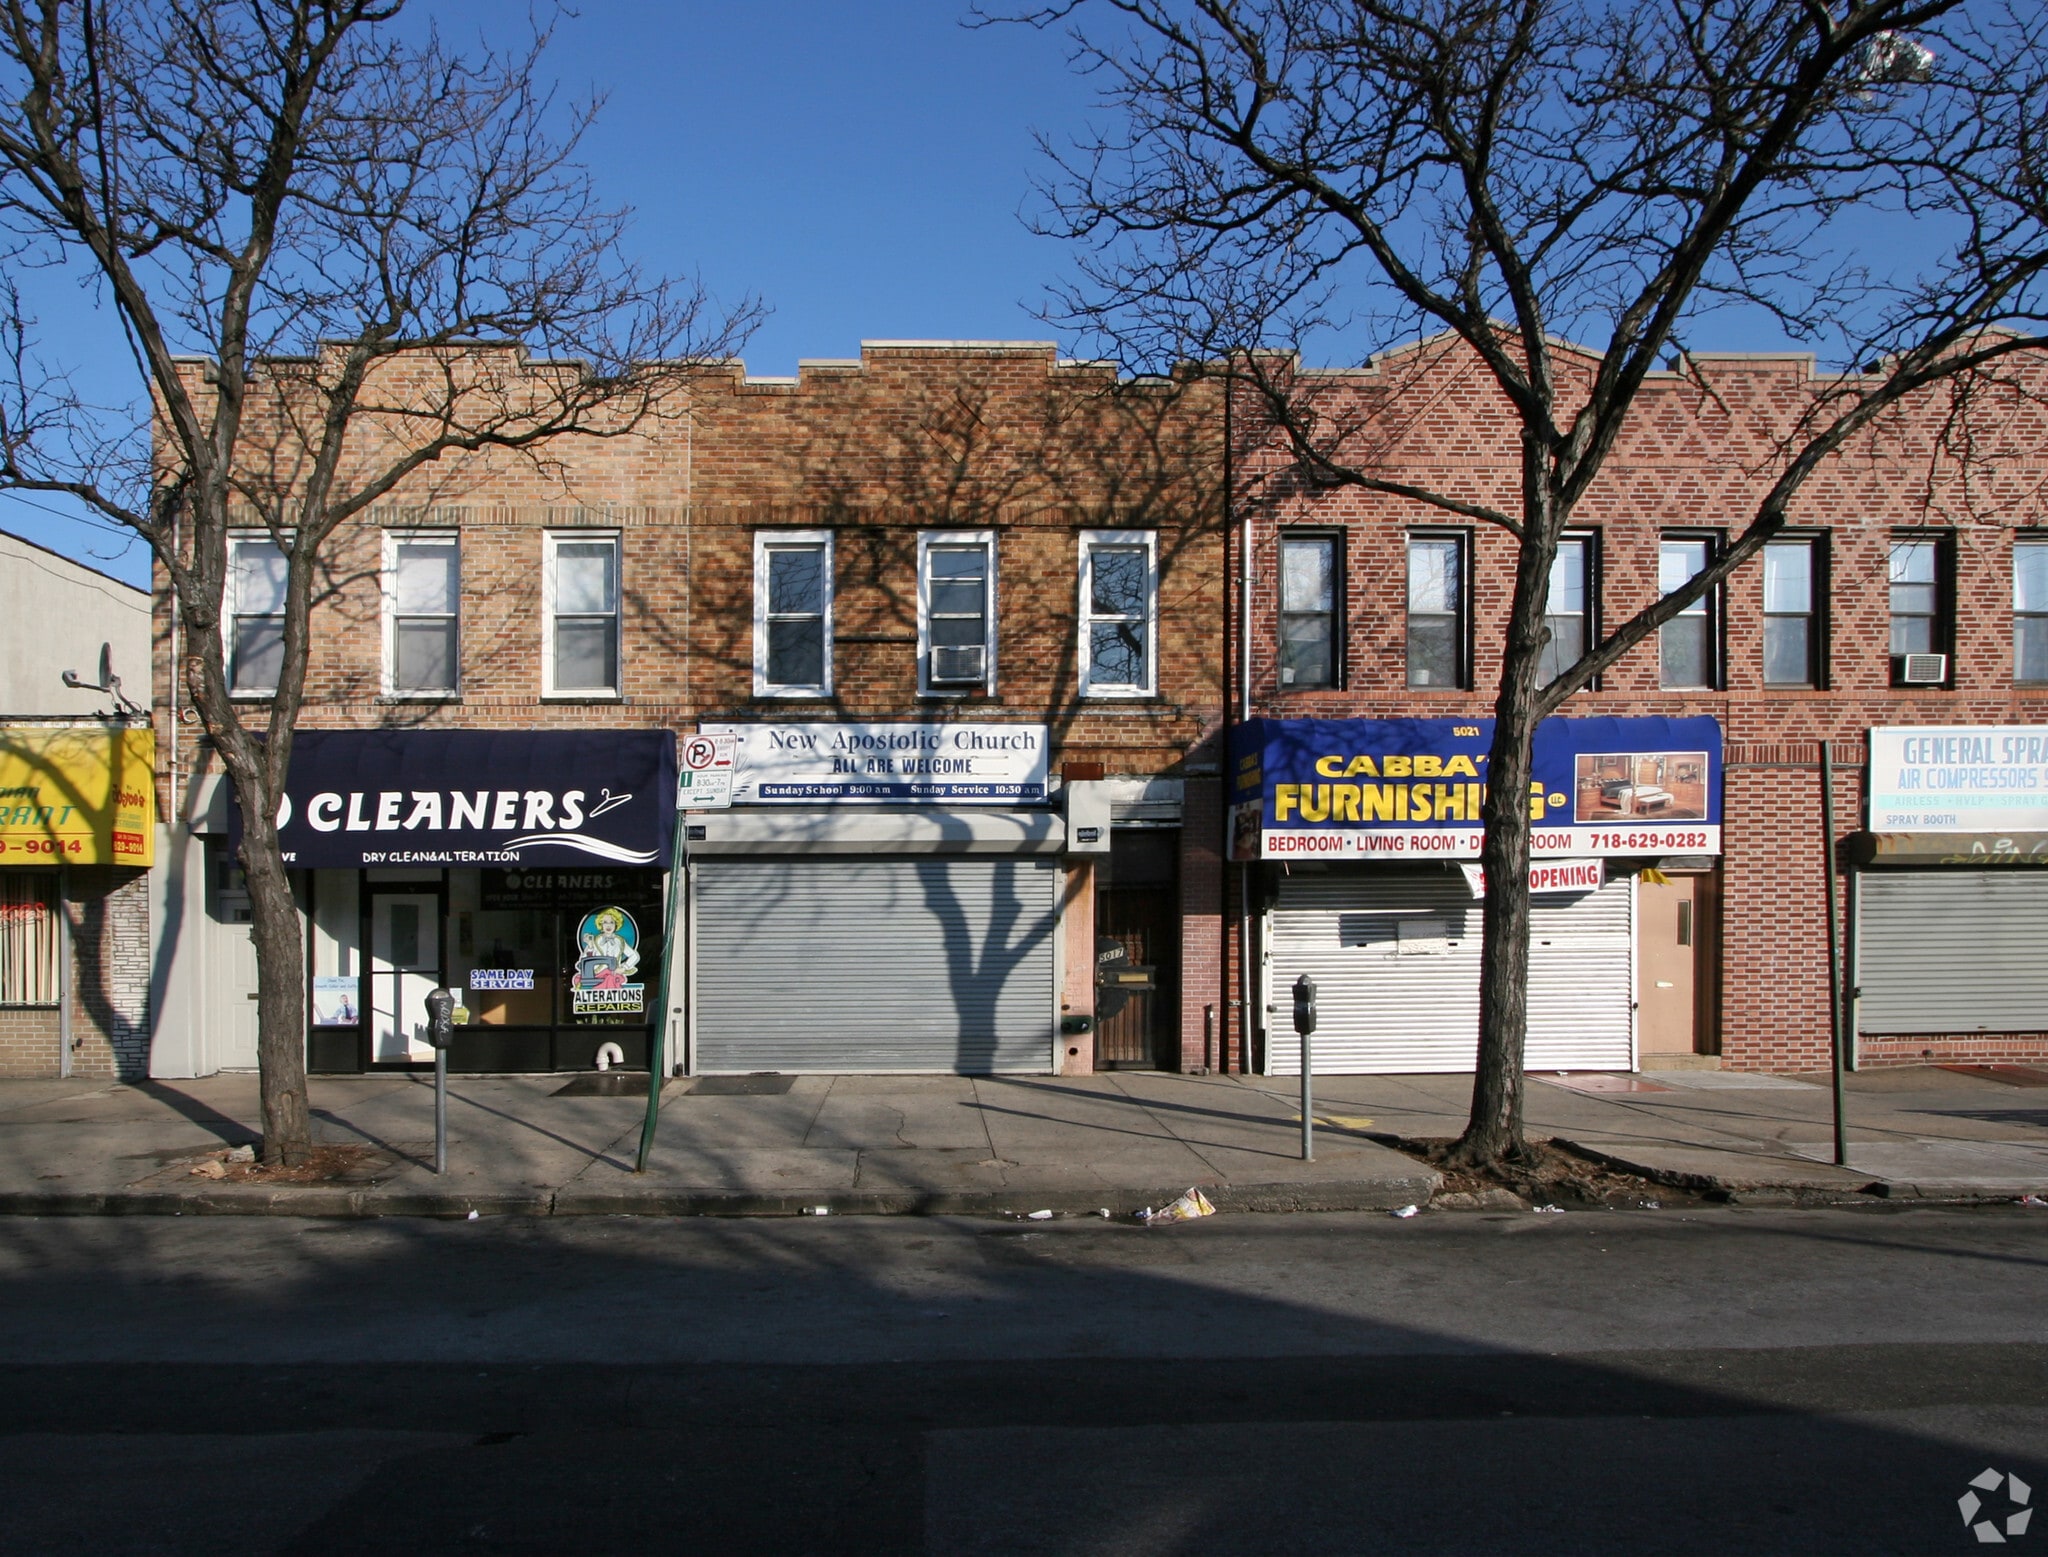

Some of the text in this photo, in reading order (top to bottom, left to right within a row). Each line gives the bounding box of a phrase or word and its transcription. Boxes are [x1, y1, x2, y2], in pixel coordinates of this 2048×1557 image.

[1453, 727, 1480, 737] 5021
[769, 730, 1036, 754] New Apostolic Church
[1903, 737, 1995, 764] GENERAL
[833, 759, 972, 773] ALL ARE WELCOME
[1315, 755, 1489, 778] CABBA'
[1898, 768, 1921, 790] AIR
[1926, 768, 2038, 789] COMPRESSORS
[764, 785, 803, 796] Sunday
[805, 785, 843, 794] School
[849, 786, 872, 794] 9:00
[911, 785, 946, 796] Sunday
[951, 785, 989, 794] Service
[995, 785, 1021, 794] 10:30
[1275, 782, 1544, 822] FURNISHIG
[1895, 796, 1939, 806] AIRLESS
[2001, 796, 2037, 806] SPRAY
[307, 790, 585, 832] CLEANERS
[1886, 815, 1956, 825] SPRAY BOOTH
[1268, 836, 1342, 851] BEDROOM
[1357, 836, 1404, 851] LIVING
[1411, 835, 1455, 851] ROOM
[1590, 833, 1707, 848] 718-629-0282
[362, 851, 520, 863] DRY CLEAN&ALTERATION
[1529, 865, 1598, 889] OPENING
[471, 970, 534, 979] SAME DAY
[471, 980, 533, 989] SERVICE
[575, 989, 642, 1003] ALTERATIONS
[575, 1002, 641, 1012] REPAIRS
